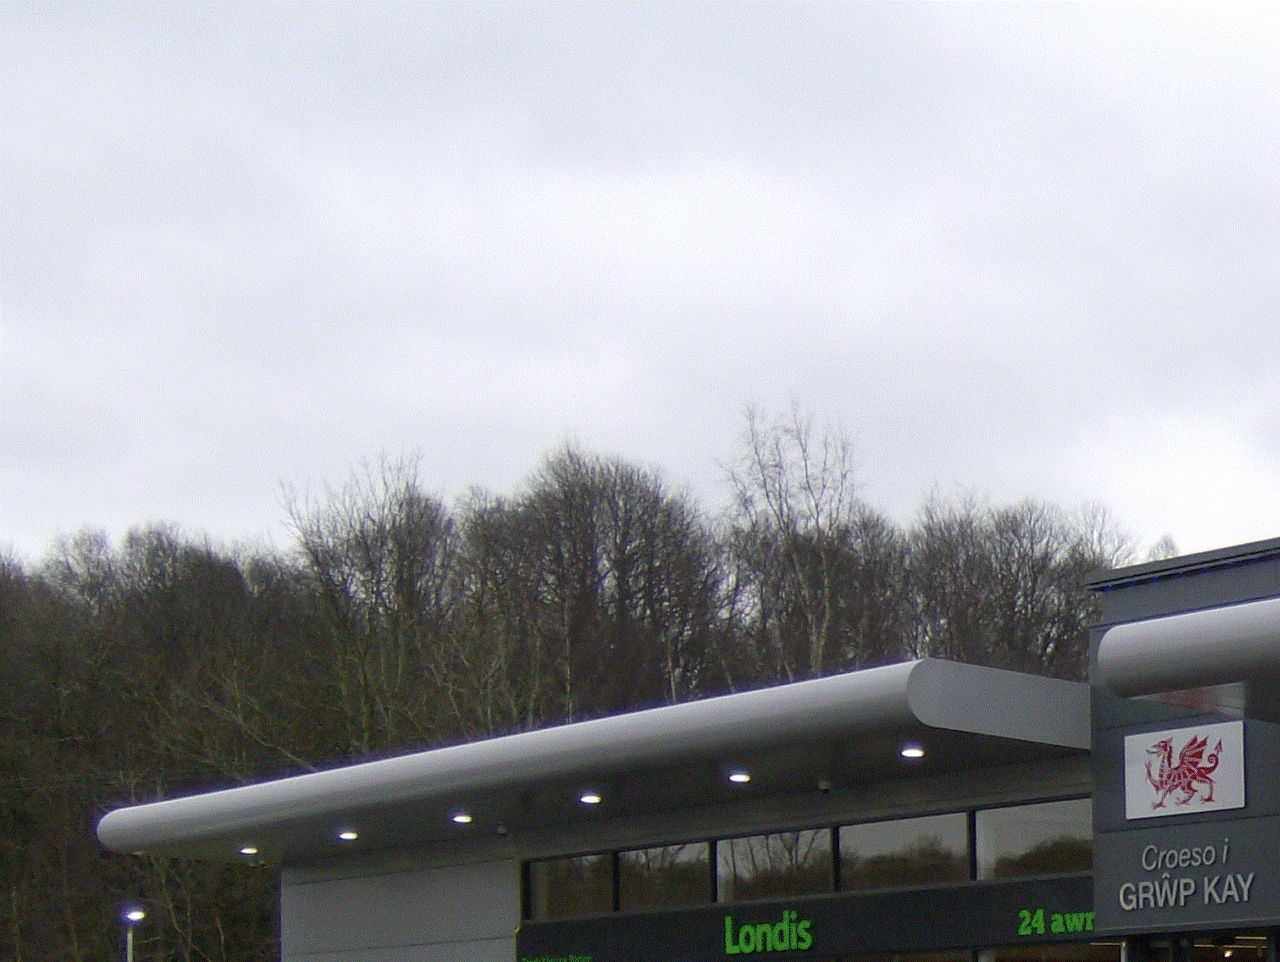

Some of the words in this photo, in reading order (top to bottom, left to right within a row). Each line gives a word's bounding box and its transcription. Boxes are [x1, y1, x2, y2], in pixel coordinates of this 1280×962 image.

[1141, 844, 1217, 872] Croeso
[1222, 838, 1229, 864] i
[1119, 873, 1193, 911] GRŴP
[1203, 872, 1255, 903] KAY
[724, 910, 813, 955] Londis
[1018, 908, 1045, 935] 24
